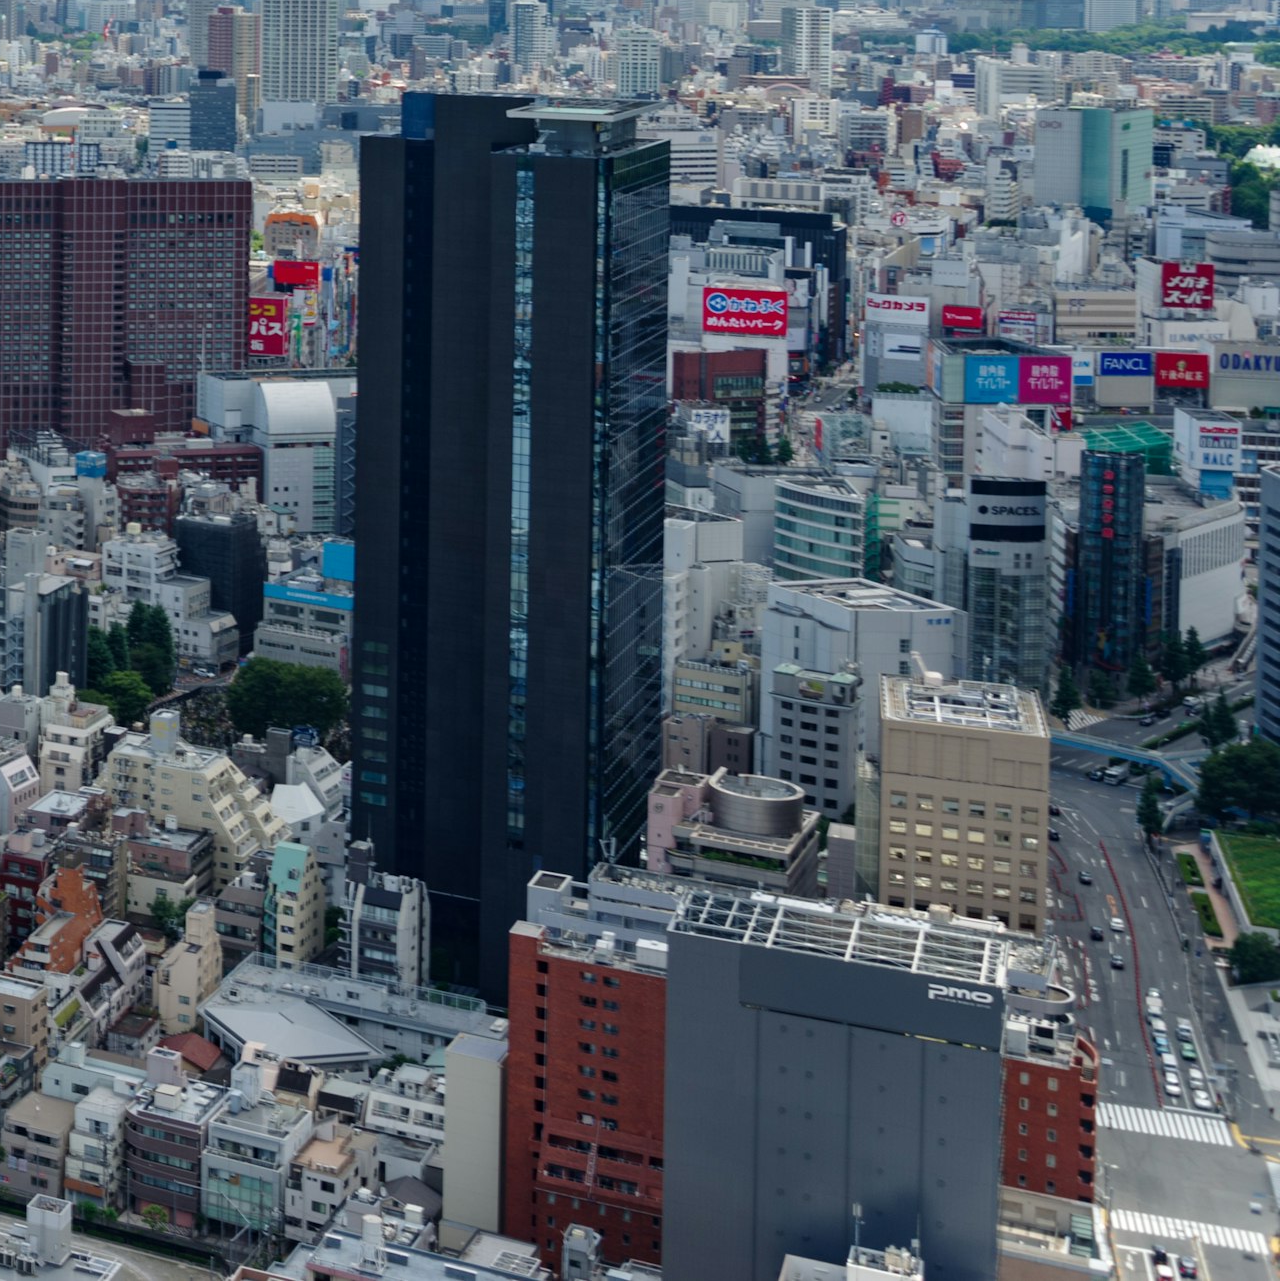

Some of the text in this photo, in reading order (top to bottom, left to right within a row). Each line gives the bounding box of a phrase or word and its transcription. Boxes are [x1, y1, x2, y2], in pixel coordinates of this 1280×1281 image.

[1166, 275, 1210, 289] メガネ
[1164, 290, 1212, 305] スーパー
[728, 298, 785, 314] かねふく
[866, 298, 926, 312] ビックカメラ
[706, 317, 784, 329] めんたいパーク
[1103, 358, 1147, 371] FANCL
[1202, 452, 1234, 465] HALC
